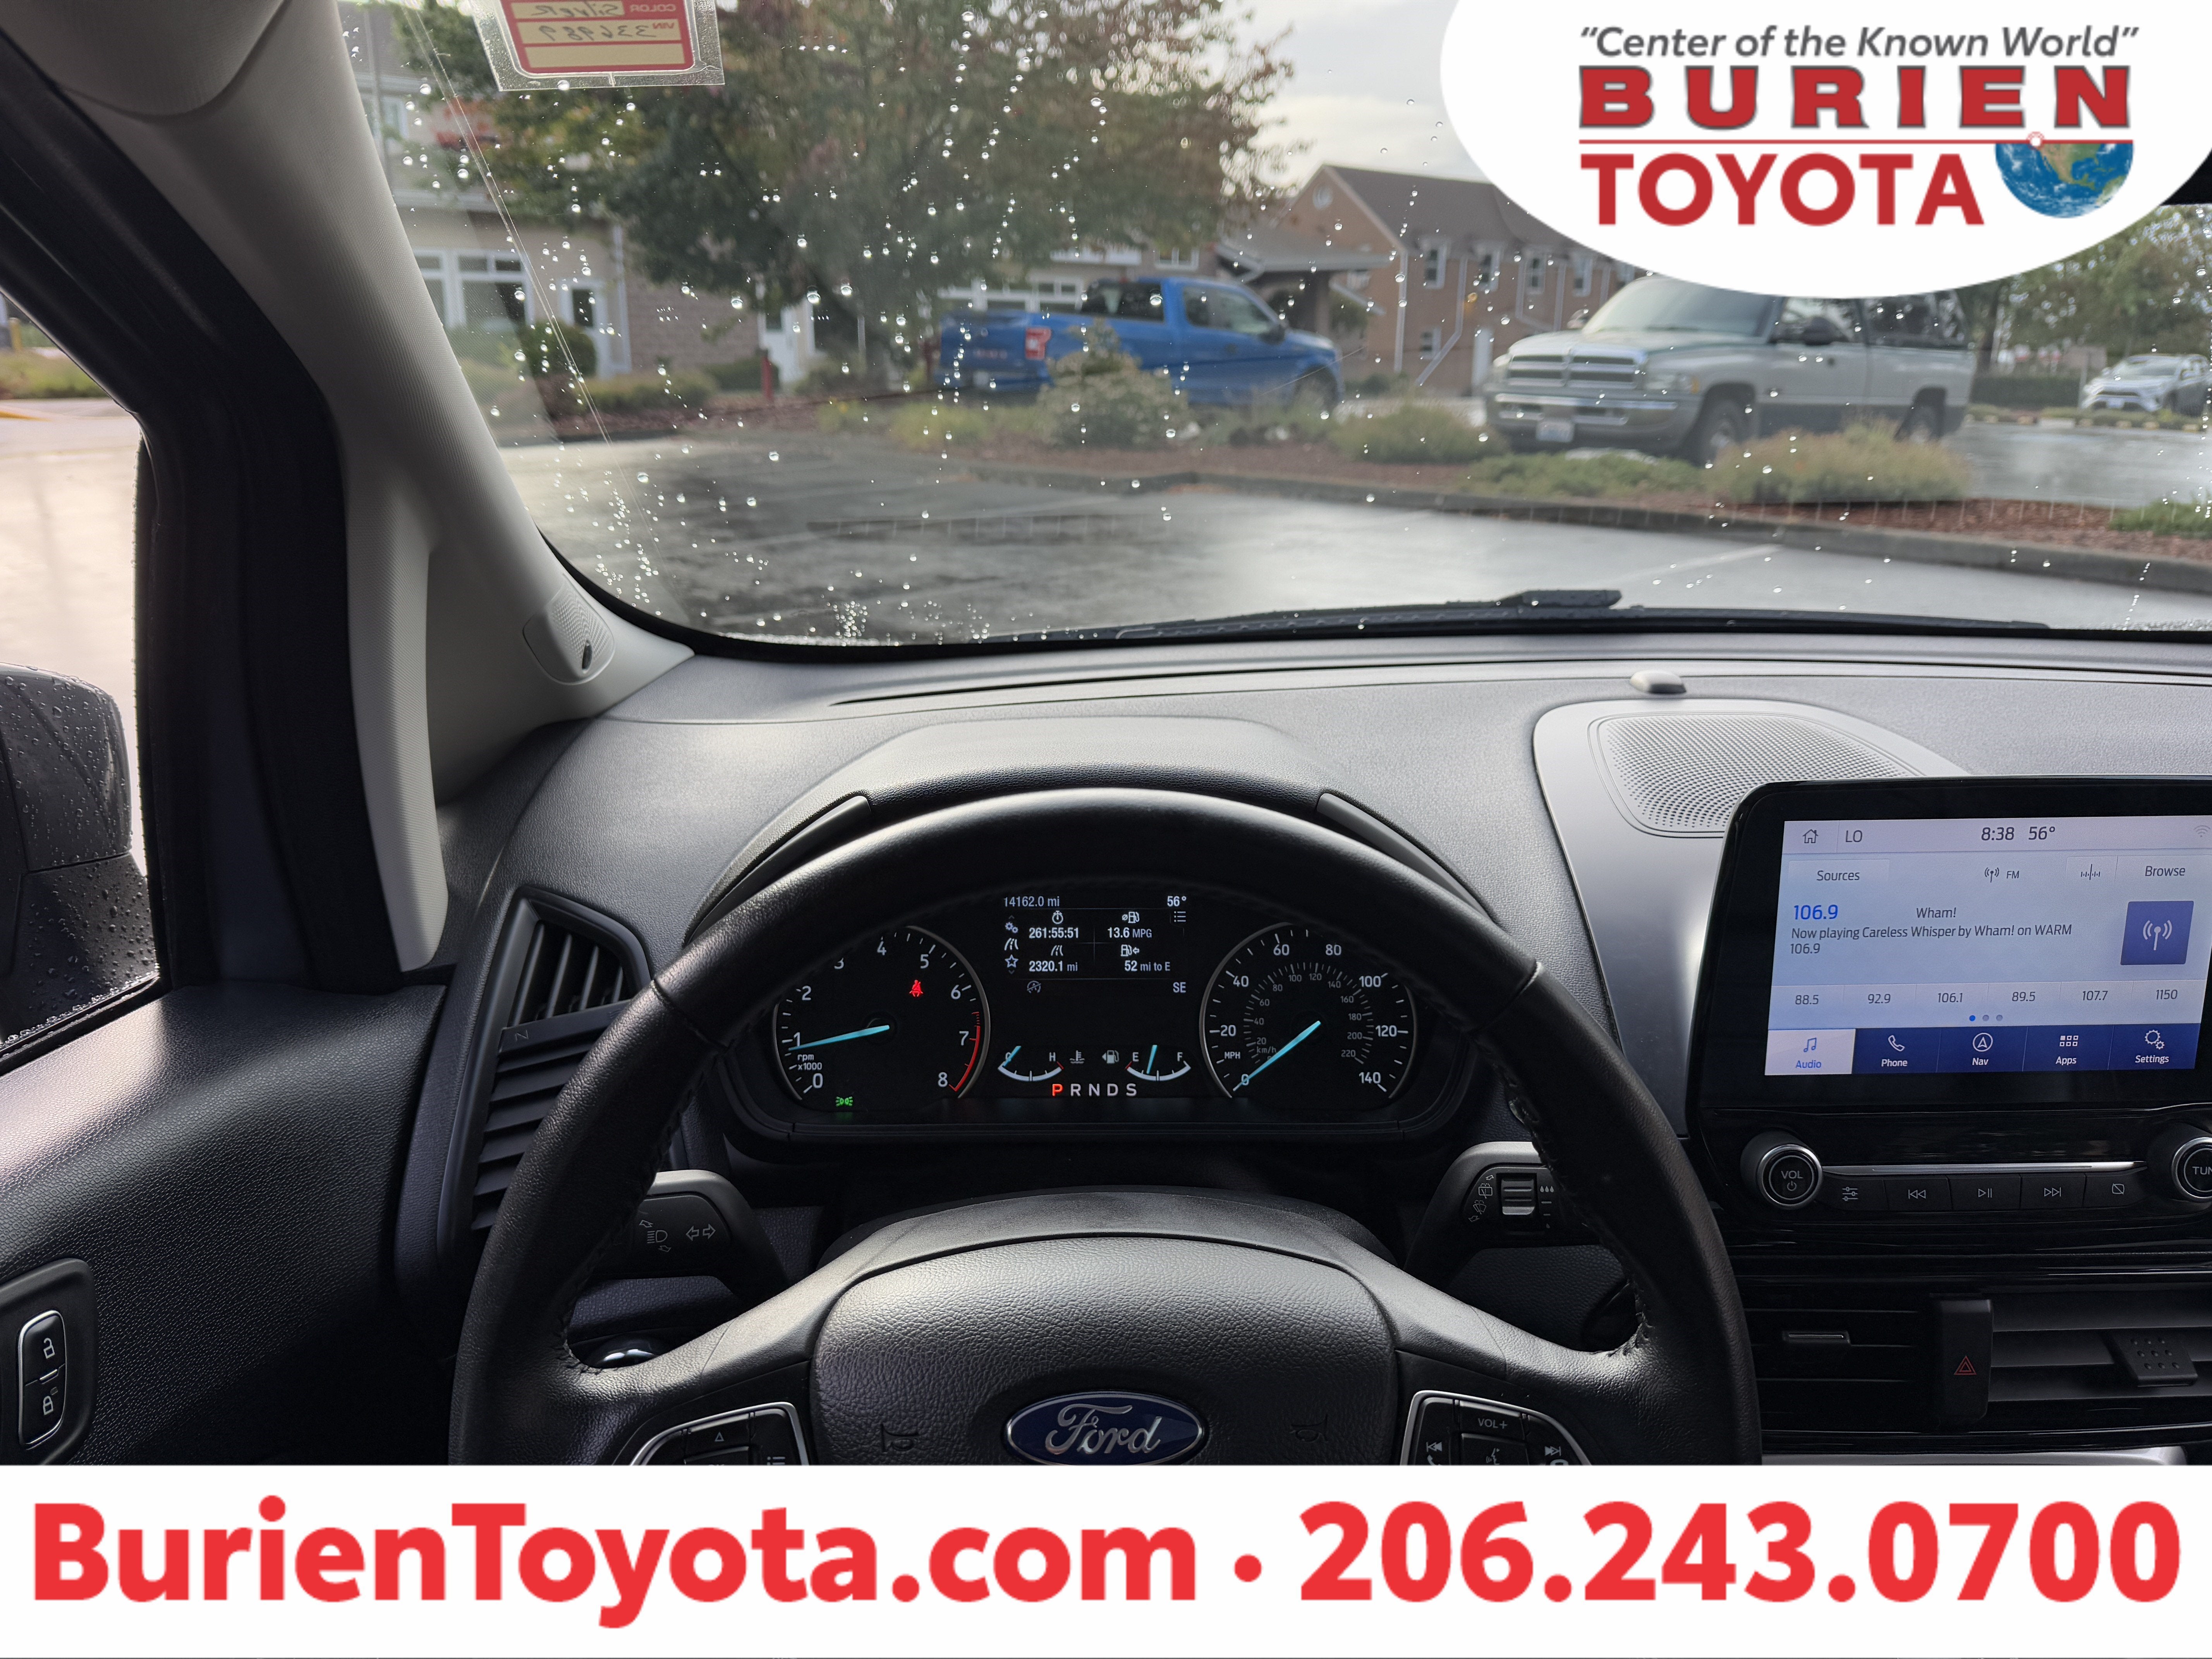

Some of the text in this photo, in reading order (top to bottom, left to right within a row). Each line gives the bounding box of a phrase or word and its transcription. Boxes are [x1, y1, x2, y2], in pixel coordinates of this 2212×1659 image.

[1845, 830, 1863, 843] LO
[1981, 827, 2014, 841] 8:38
[1816, 870, 1860, 881] Sources
[2006, 870, 2020, 879] FM
[2145, 866, 2186, 876] Browse
[1005, 896, 1060, 907] 14162.0 mi
[1794, 904, 1838, 920] 106.9
[1916, 907, 1956, 918] Wham!
[1029, 927, 1079, 939] 261:55:51
[1108, 927, 1152, 938] 13.6 MPG
[1791, 924, 2072, 940] Now playing Careless Whisper by Wham! on WARM
[877, 941, 887, 955] 4
[1273, 944, 1290, 956] 60
[1325, 944, 1341, 956] 80
[1790, 943, 1820, 954] 106.9
[920, 954, 929, 969] 5
[1029, 960, 1078, 972] 2320.1 mi
[1125, 960, 1170, 971] 52 mi to E
[1233, 976, 1249, 987] 40
[1359, 975, 1381, 987] 100
[802, 986, 811, 1000] 2
[951, 984, 961, 1000] 6
[1173, 982, 1186, 993] SE
[1795, 989, 2178, 1005] 88.5 92.9 106.1 89.5 107.7 1150
[1221, 1025, 1236, 1036] 20
[1347, 1032, 1362, 1040] 200
[1375, 1025, 1397, 1037] 120
[793, 1032, 801, 1046] 1
[959, 1031, 969, 1046] 7
[1049, 1052, 1056, 1061] H
[1132, 1052, 1139, 1062] E
[1177, 1052, 1183, 1061] F
[1881, 1055, 2169, 1067] Phone Nav Apps Settings
[798, 1062, 822, 1070] x1000
[1795, 1060, 1822, 1068] Audio
[812, 1073, 823, 1088] 0
[938, 1072, 948, 1087] 8
[1359, 1072, 1381, 1084] 140
[1052, 1083, 1137, 1096] P R N D S
[1781, 1170, 1803, 1179] VOL
[1046, 1403, 1162, 1455] Ford
